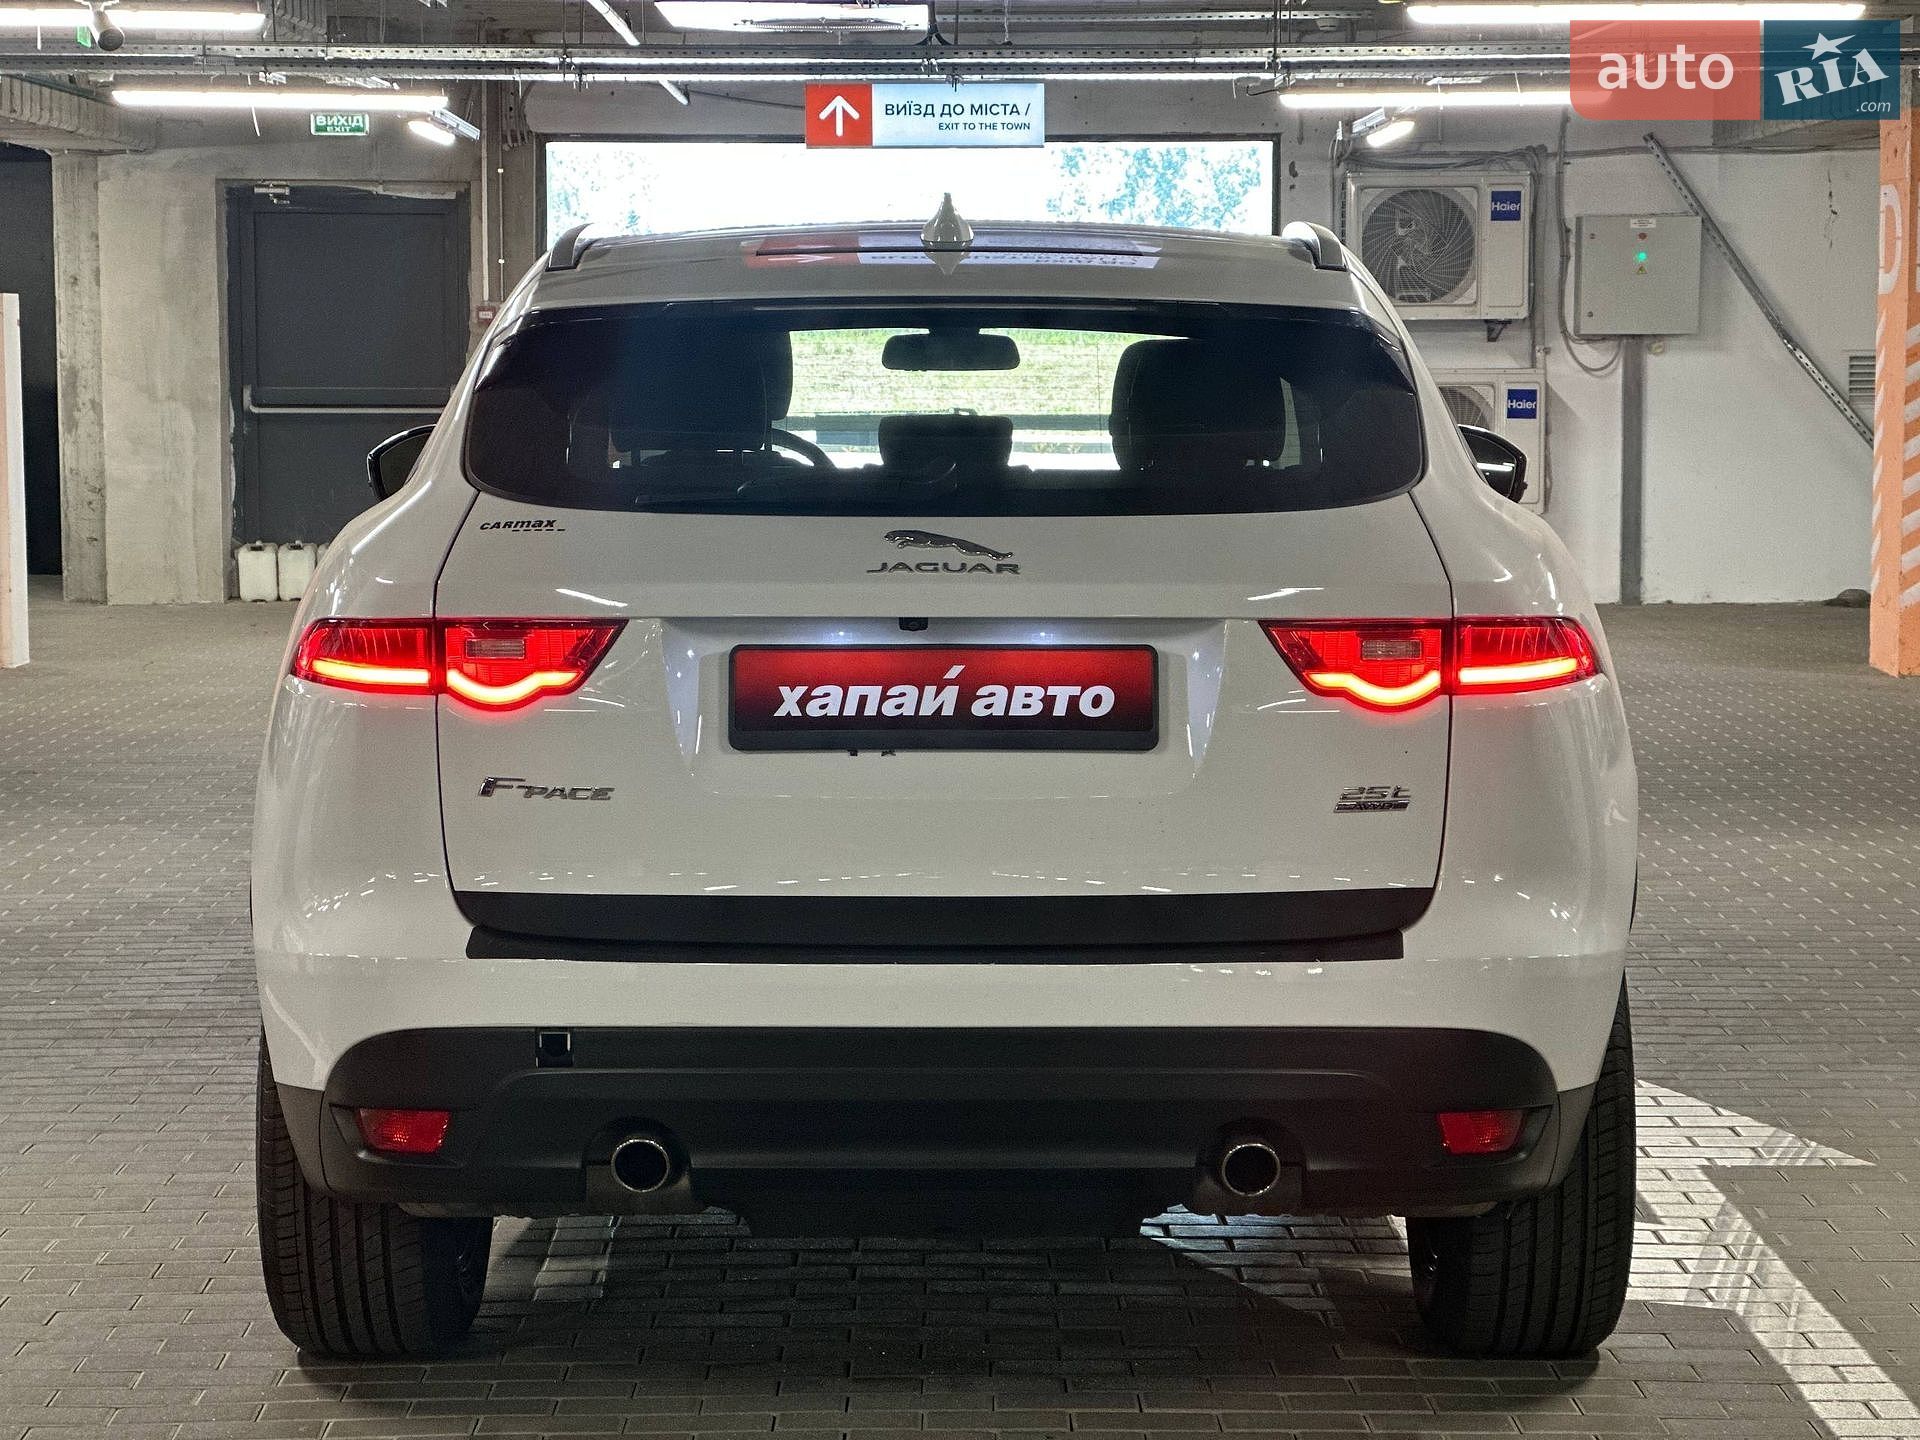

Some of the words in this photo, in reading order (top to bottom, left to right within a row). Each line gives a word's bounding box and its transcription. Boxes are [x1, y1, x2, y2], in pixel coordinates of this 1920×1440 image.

[884, 101, 935, 118] ВИЇЗД
[940, 103, 965, 118] ДО
[970, 103, 1021, 117] МІСТА
[316, 115, 364, 128] ВИХІД
[938, 122, 960, 131] EXIT
[963, 122, 976, 131] TO
[979, 122, 998, 131] THE
[1000, 122, 1031, 131] TOWN
[1491, 201, 1521, 211] Haier
[1507, 399, 1537, 409] Haier
[866, 561, 1021, 575] JAGUAR
[970, 684, 1115, 718] авто
